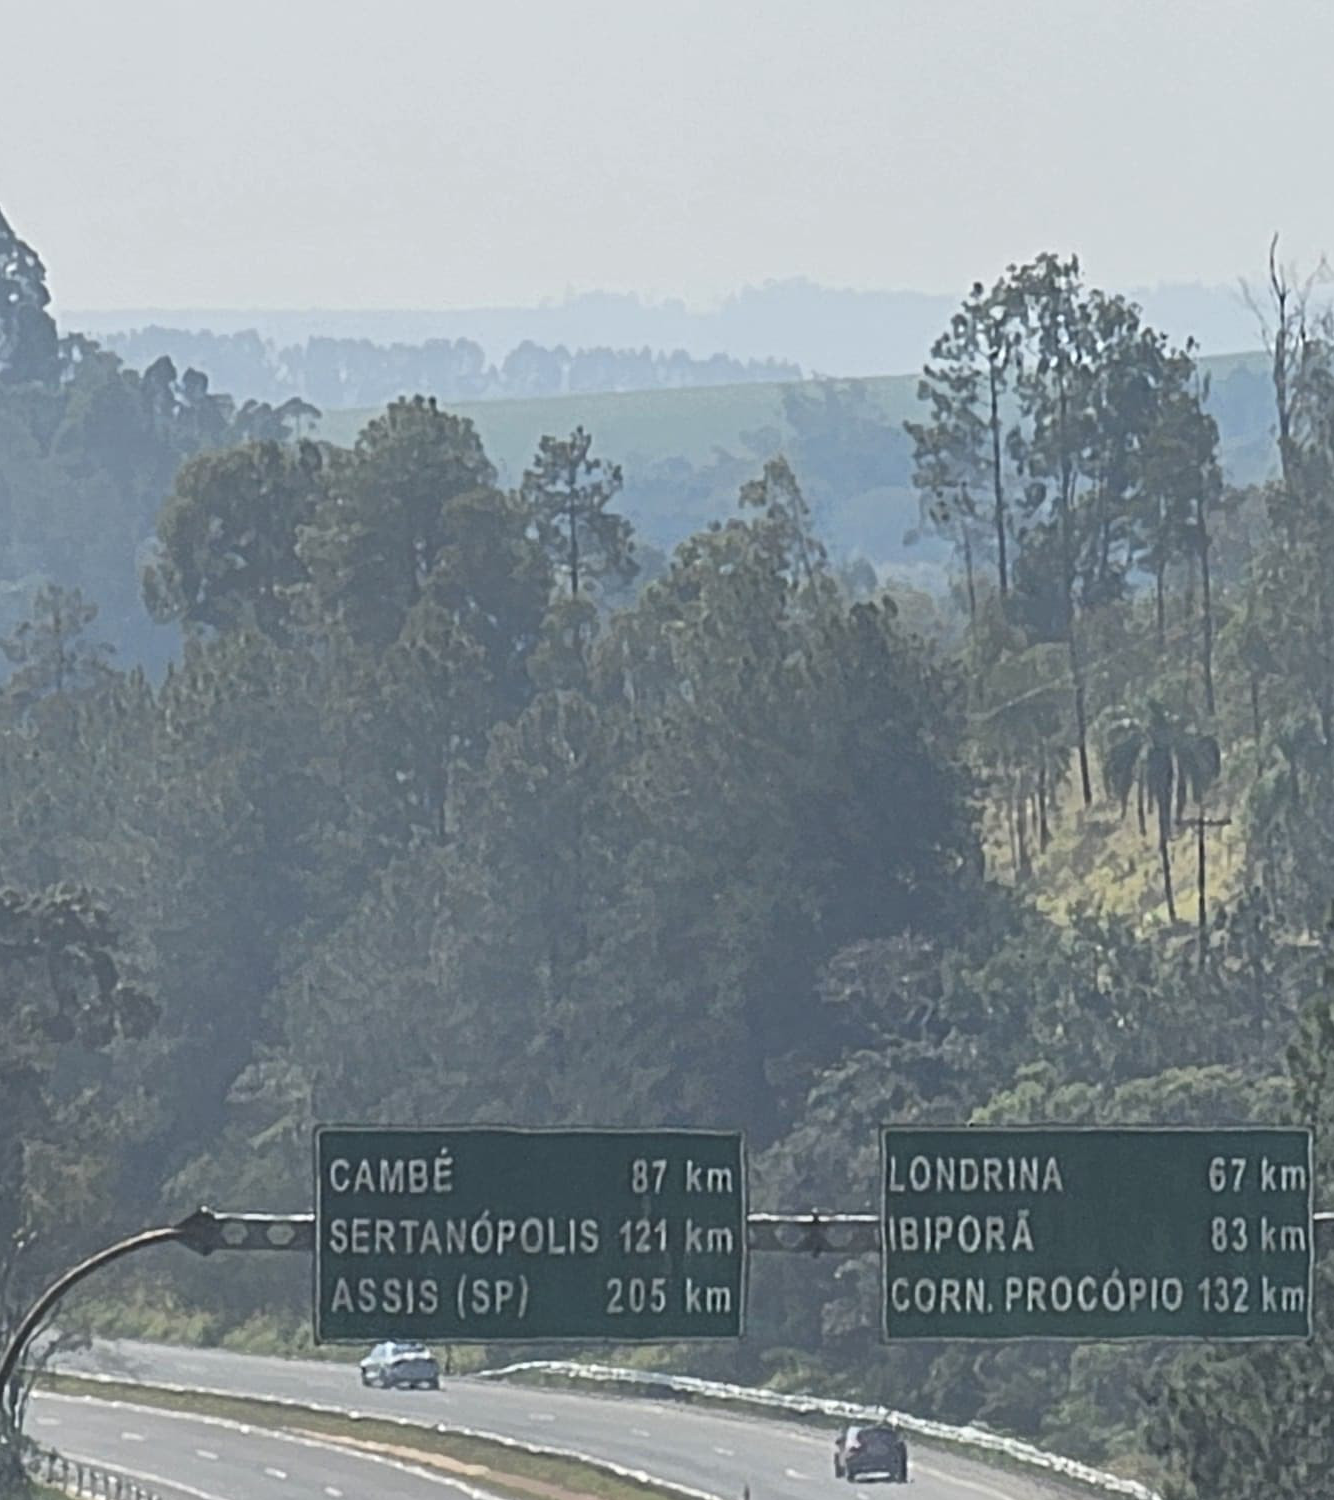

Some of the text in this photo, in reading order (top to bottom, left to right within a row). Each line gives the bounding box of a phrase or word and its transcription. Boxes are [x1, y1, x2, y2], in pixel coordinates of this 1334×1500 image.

[329, 1148, 734, 1194] CAMBÉ 87 km
[889, 1156, 1307, 1193] LONDRINA 67 km
[329, 1211, 734, 1254] SERTANÓPOLIS 121 km
[889, 1209, 1307, 1253] IBIPORÃ 83 km
[331, 1273, 733, 1319] ASSIS (SP) 205 km
[891, 1267, 1306, 1314] CORN. PROCÓPIO 132 km
